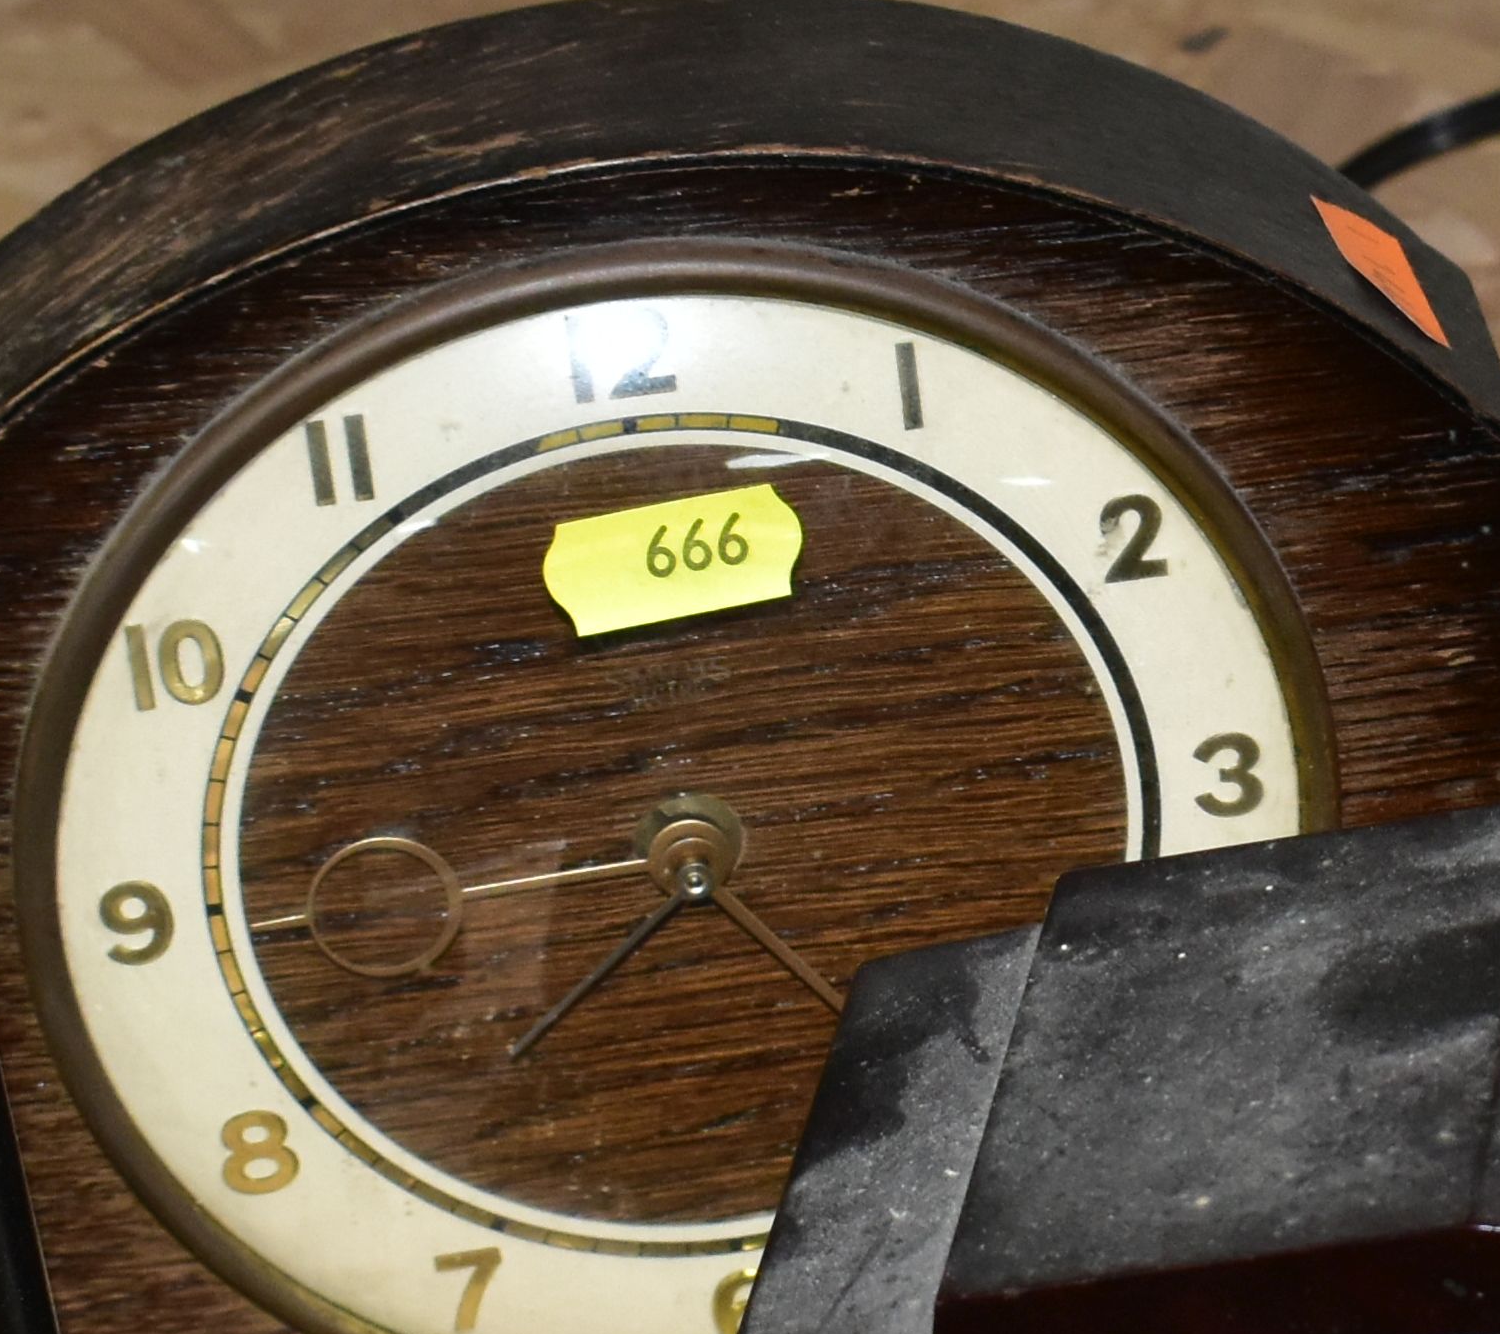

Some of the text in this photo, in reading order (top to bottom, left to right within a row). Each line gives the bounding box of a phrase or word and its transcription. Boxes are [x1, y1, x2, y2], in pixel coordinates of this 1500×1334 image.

[894, 341, 926, 431] 1
[304, 414, 376, 507] 11
[645, 514, 751, 578] 666
[1097, 492, 1169, 584] 2
[123, 616, 226, 712] 10
[1190, 731, 1266, 819] 3
[98, 878, 176, 968] 9
[219, 1108, 300, 1196] 8
[433, 1247, 504, 1333] 7
